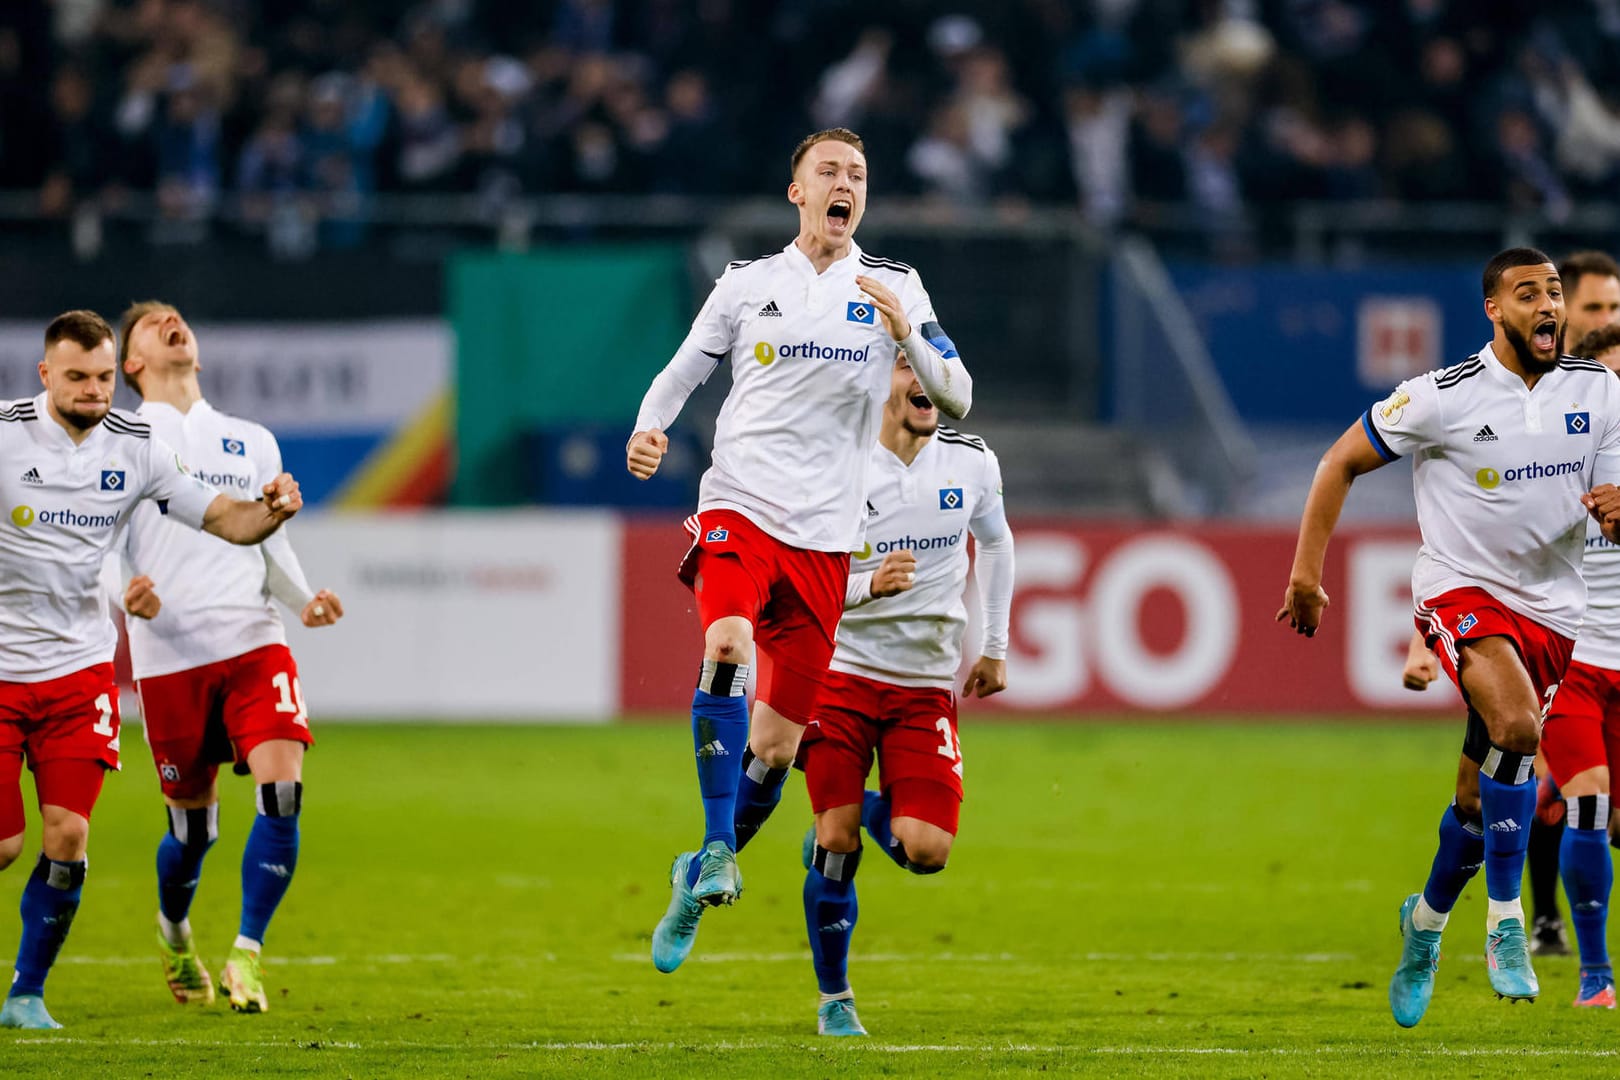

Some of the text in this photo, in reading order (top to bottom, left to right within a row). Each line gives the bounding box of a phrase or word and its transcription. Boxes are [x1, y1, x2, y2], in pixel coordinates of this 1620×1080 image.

[779, 341, 870, 362] orthomol
[1473, 434, 1499, 442] adidas
[1504, 456, 1586, 481] orthomol
[39, 508, 121, 527] orthomol
[876, 528, 963, 554] orthomol
